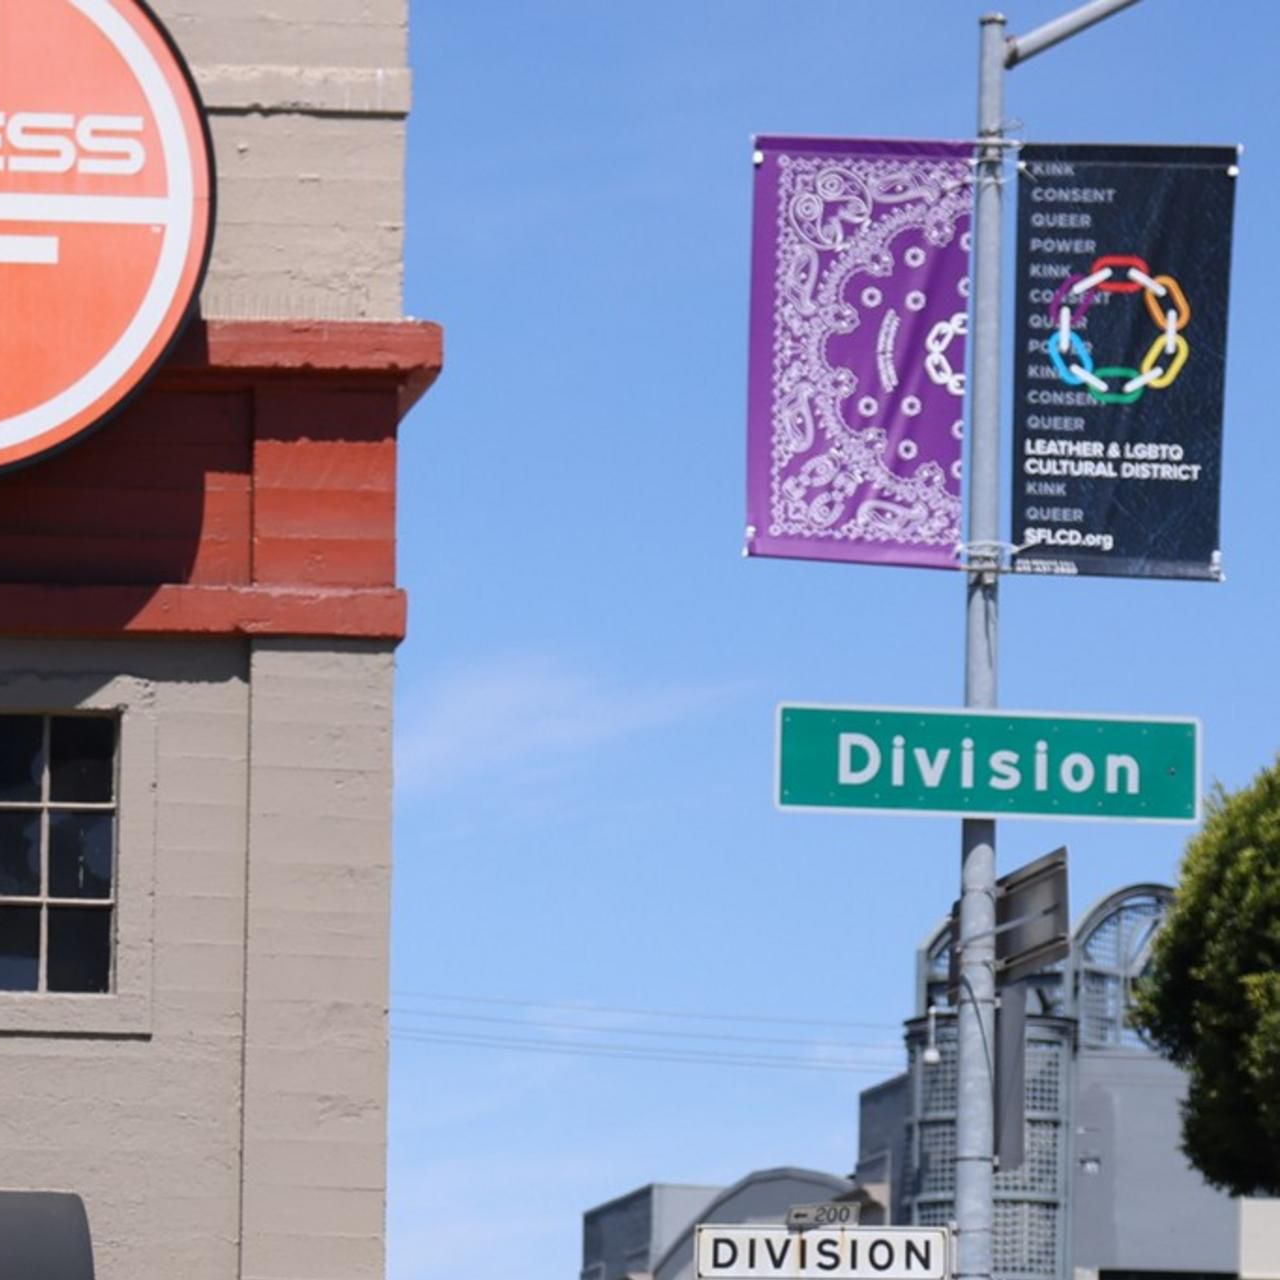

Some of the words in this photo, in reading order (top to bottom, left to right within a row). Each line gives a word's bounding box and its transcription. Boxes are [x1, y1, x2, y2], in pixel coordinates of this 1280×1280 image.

[1030, 162, 1075, 176] KINK
[1031, 187, 1117, 202] CONSENT
[1031, 213, 1092, 228] QUEER
[1030, 238, 1097, 254] POWER
[1029, 263, 1071, 278] KINK
[1026, 415, 1085, 431] QUEER
[1025, 438, 1105, 457] LEATHER
[1107, 442, 1121, 457] &
[1124, 443, 1184, 461] LGBTQ
[1024, 458, 1117, 477] CULTURAL
[1121, 462, 1202, 480] DISTRICT
[1026, 481, 1067, 496] KINK
[1026, 506, 1084, 522] QUEER
[1024, 527, 1114, 551] SFLCD.org
[838, 732, 1140, 795] Division
[814, 1207, 850, 1223] 200
[712, 1238, 931, 1271] DIVISION
